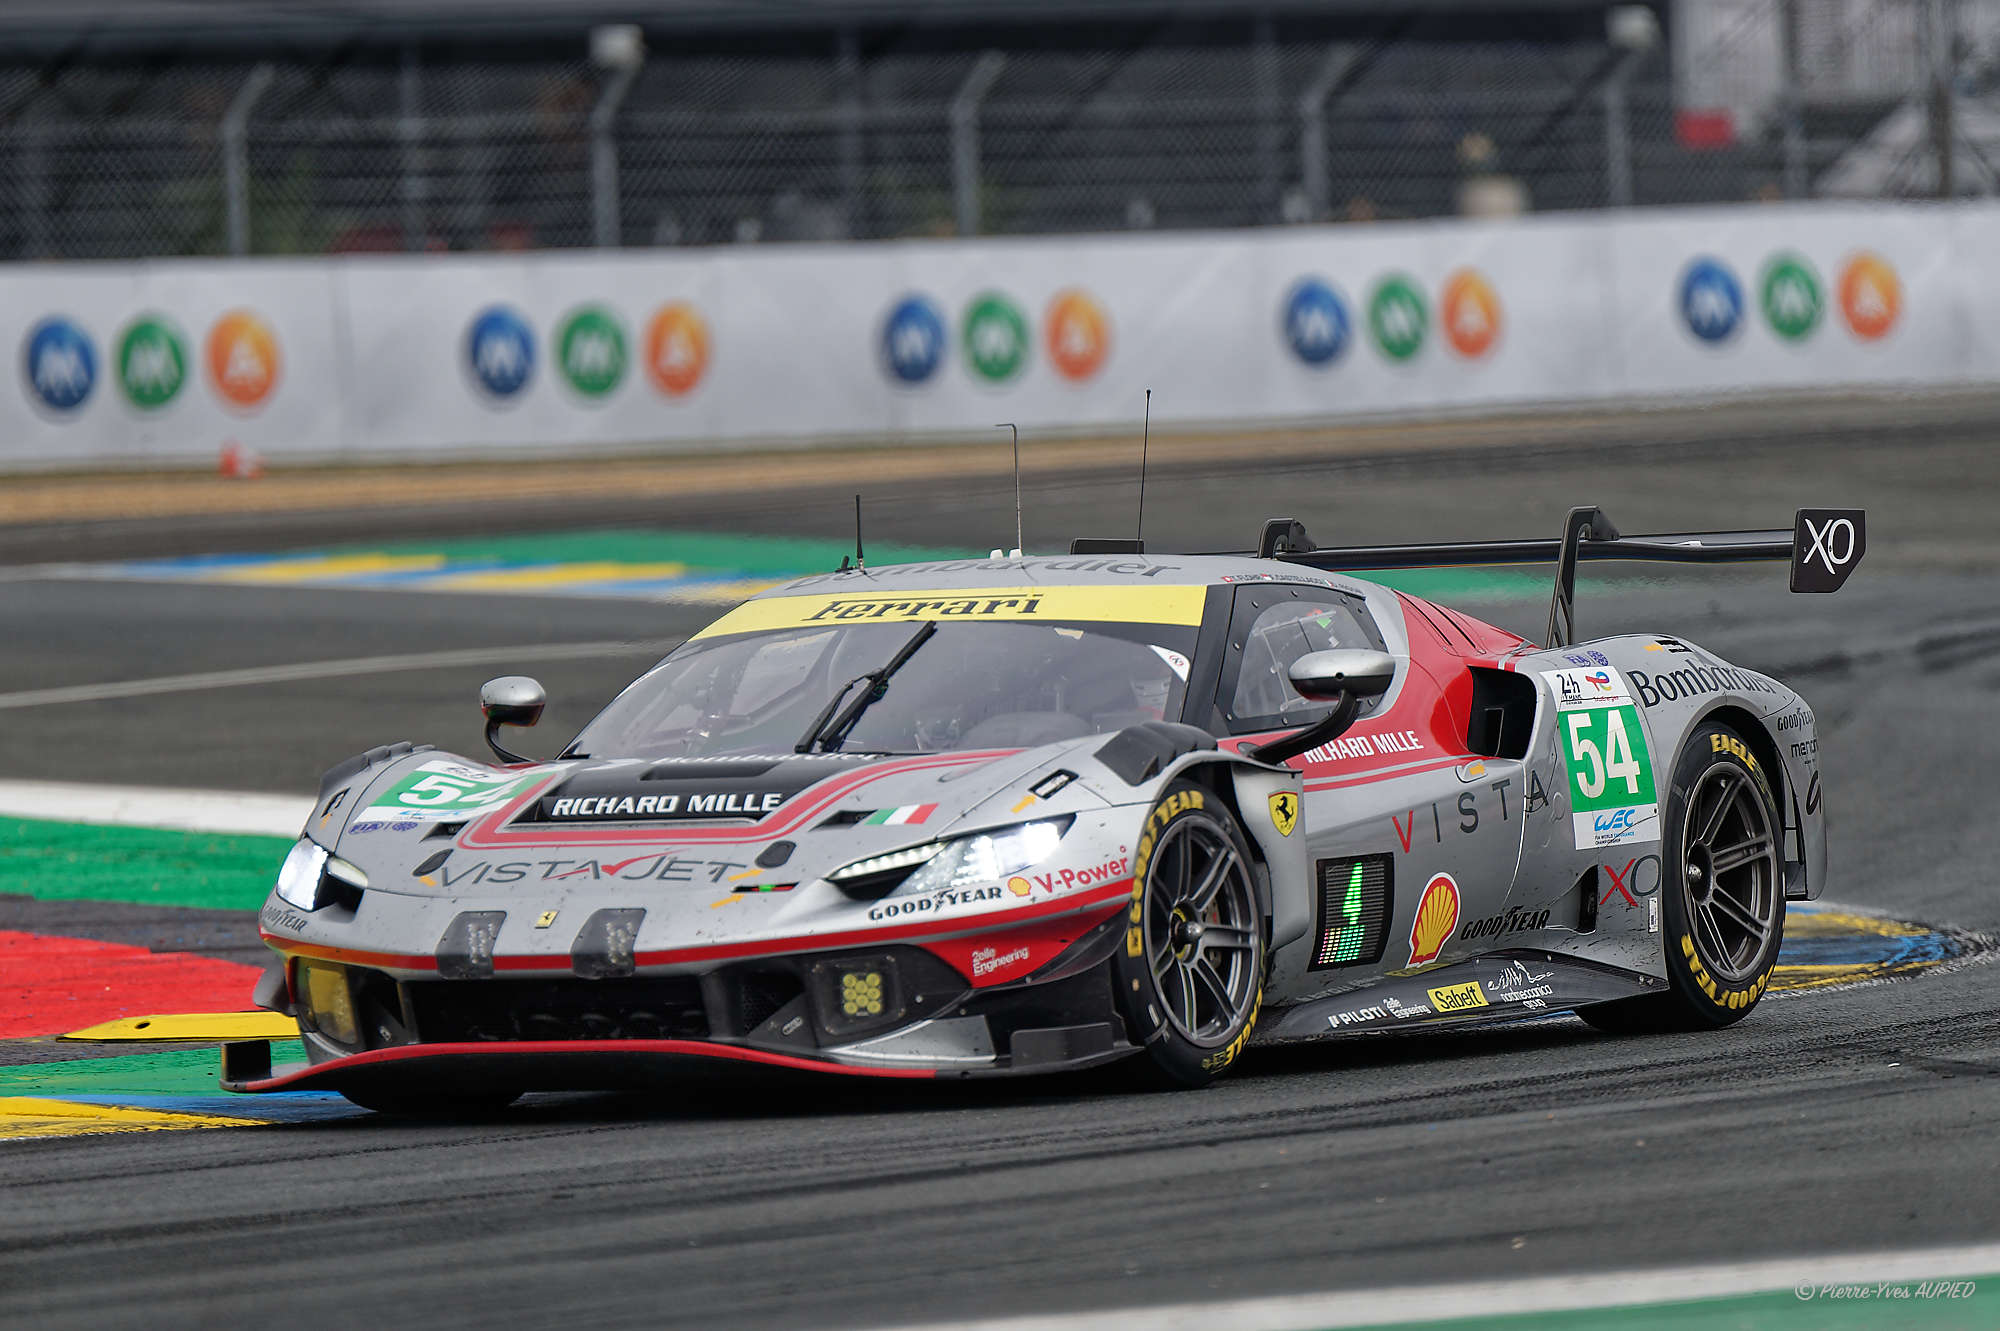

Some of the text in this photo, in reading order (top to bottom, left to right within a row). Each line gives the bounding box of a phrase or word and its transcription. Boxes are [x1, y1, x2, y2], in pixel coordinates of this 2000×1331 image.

[1803, 518, 1855, 575] XO
[803, 593, 1044, 621] Ferrari
[1626, 659, 1777, 708] Bombardier
[1371, 730, 1424, 755] MILLE
[1568, 709, 1640, 799] 54
[1709, 734, 1757, 773] EAGLE
[399, 774, 527, 806] 54
[552, 793, 783, 816] RICHARD MILLE
[1392, 770, 1549, 854] VISTA
[1594, 809, 1636, 832] WEC
[1034, 857, 1128, 894] V-Power
[1600, 854, 1662, 907] XO
[868, 887, 1002, 921] GOODYEAR
[1461, 905, 1550, 941] GOODYEAR
[973, 947, 1029, 977] Engineering
[1338, 1005, 1387, 1024] PILOTI
[1434, 985, 1482, 1010] Sabelt
